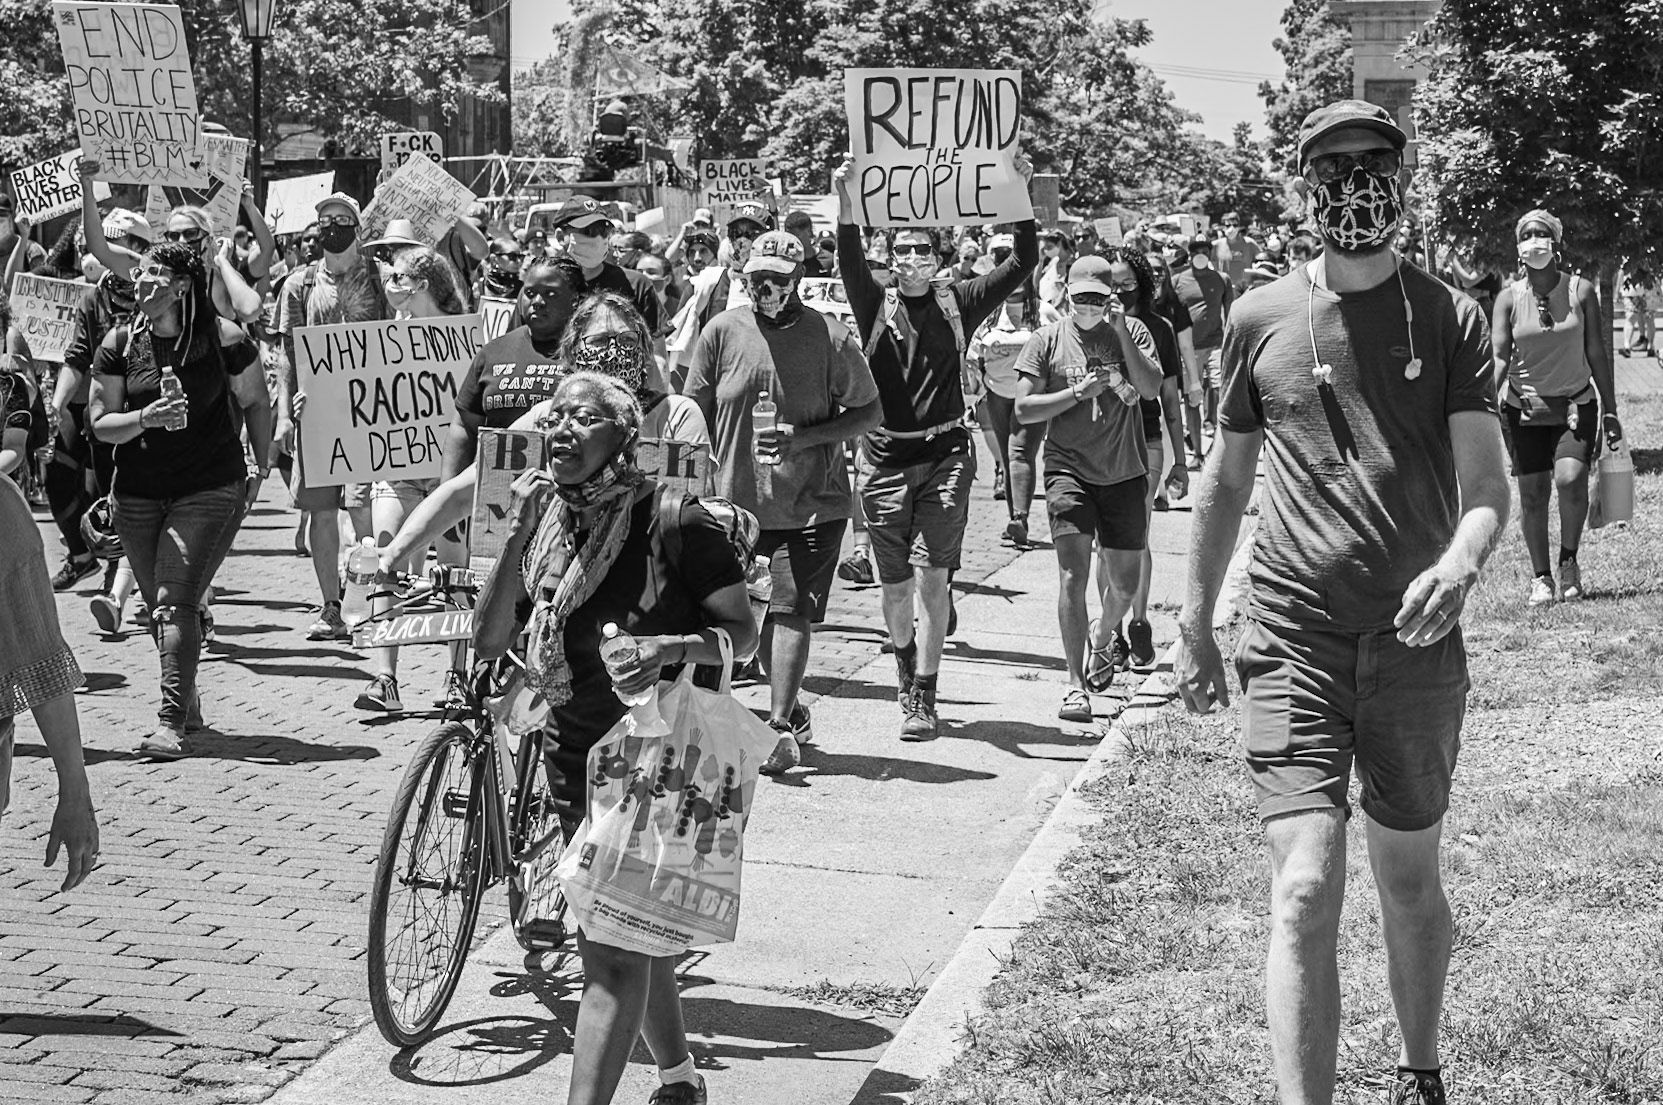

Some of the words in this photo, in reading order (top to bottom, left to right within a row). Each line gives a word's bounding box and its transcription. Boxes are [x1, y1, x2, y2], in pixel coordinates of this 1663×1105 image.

[77, 8, 178, 60] END
[67, 64, 191, 109] POLICE
[78, 109, 199, 145] BRUTALITY
[863, 76, 1021, 154] REFUND
[13, 157, 65, 187] BLACK
[105, 143, 187, 169] #BLM
[706, 162, 760, 179] BLACK
[925, 147, 962, 165] THE
[17, 175, 60, 202] LIVES
[407, 169, 445, 203] NEUTRAL
[446, 197, 461, 212] IN
[411, 155, 426, 168] IF
[424, 164, 444, 181] YOU
[440, 175, 466, 200] ARE
[716, 179, 755, 192] LIVES
[21, 183, 82, 215] MATTER
[395, 175, 445, 215] SITUATIONS
[708, 191, 760, 205] MATTER
[861, 164, 997, 226] PEOPLE
[26, 300, 36, 309] IS
[42, 303, 50, 311] A
[302, 329, 367, 375] WHY
[378, 325, 404, 365] IS
[407, 325, 483, 362] ENDING
[492, 363, 516, 376] WE
[525, 364, 566, 376] STIL
[499, 376, 554, 391] CAN'T
[348, 370, 458, 428] RACISM
[486, 393, 554, 411] BREAT
[329, 437, 353, 474] A
[372, 615, 433, 642] BLACK
[440, 613, 473, 636] LIV
[659, 877, 732, 922] ALDI
[593, 898, 602, 906] Be
[601, 902, 619, 913] proud
[651, 922, 663, 931] you
[662, 926, 675, 935] just
[674, 928, 694, 942] bought
[598, 907, 610, 916] bag
[609, 912, 627, 923] made
[626, 918, 640, 929] with
[640, 923, 665, 939] recycled
